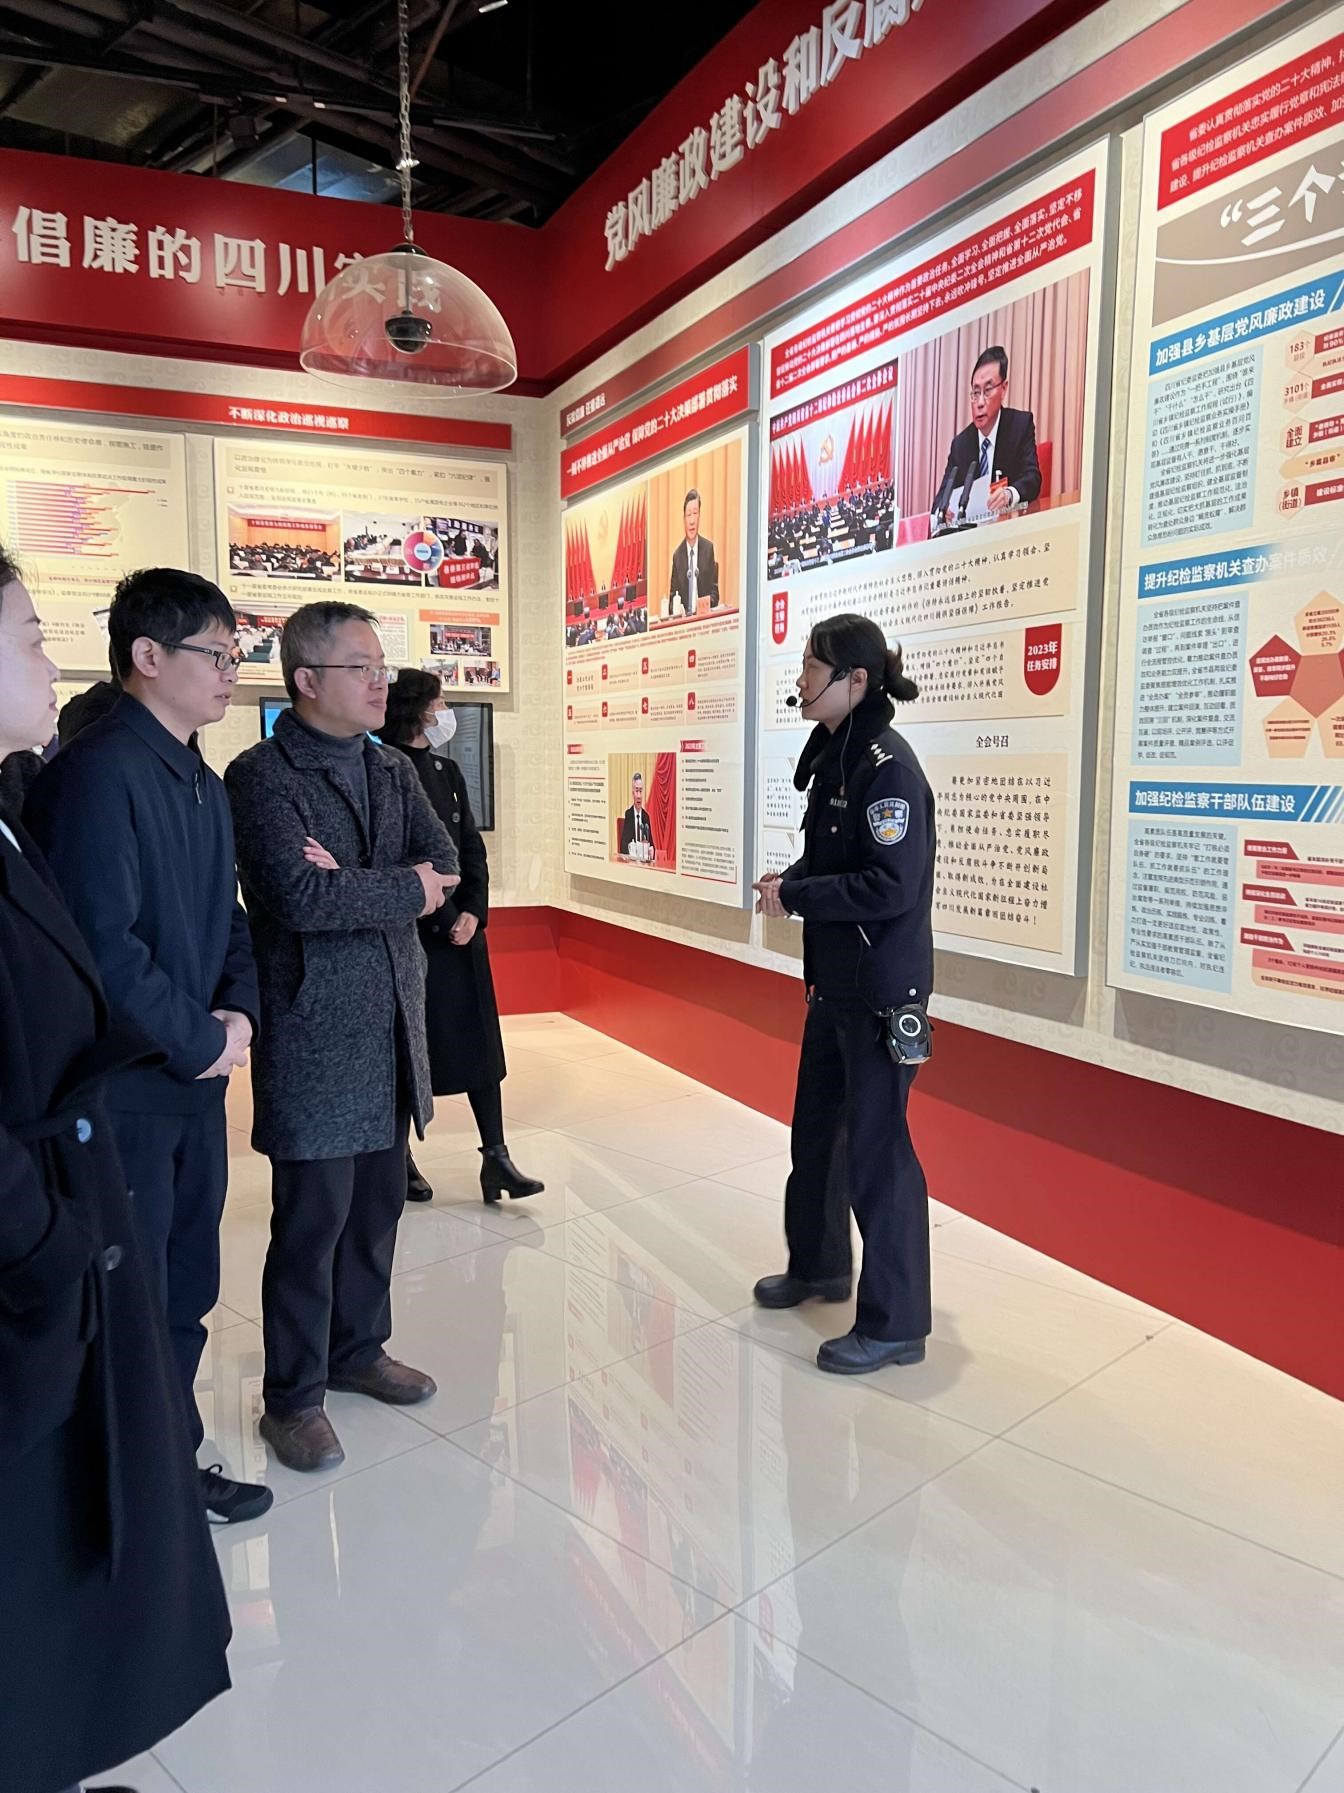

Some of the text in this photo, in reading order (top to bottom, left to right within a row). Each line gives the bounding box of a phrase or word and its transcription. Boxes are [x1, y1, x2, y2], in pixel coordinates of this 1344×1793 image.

[604, 0, 924, 272] 党风廉政建设和反腐
[1220, 161, 1344, 246] “三个
[1156, 288, 1326, 366] 加强县乡基层党风廉政建设
[1144, 544, 1329, 590] 提升纪检监察机关查办案件质效
[1027, 641, 1058, 656] 2023年
[1027, 658, 1057, 672] 任务安排
[976, 735, 1009, 748] 全会号召
[1135, 790, 1295, 813] 加强纪检监察干部队伍建设
